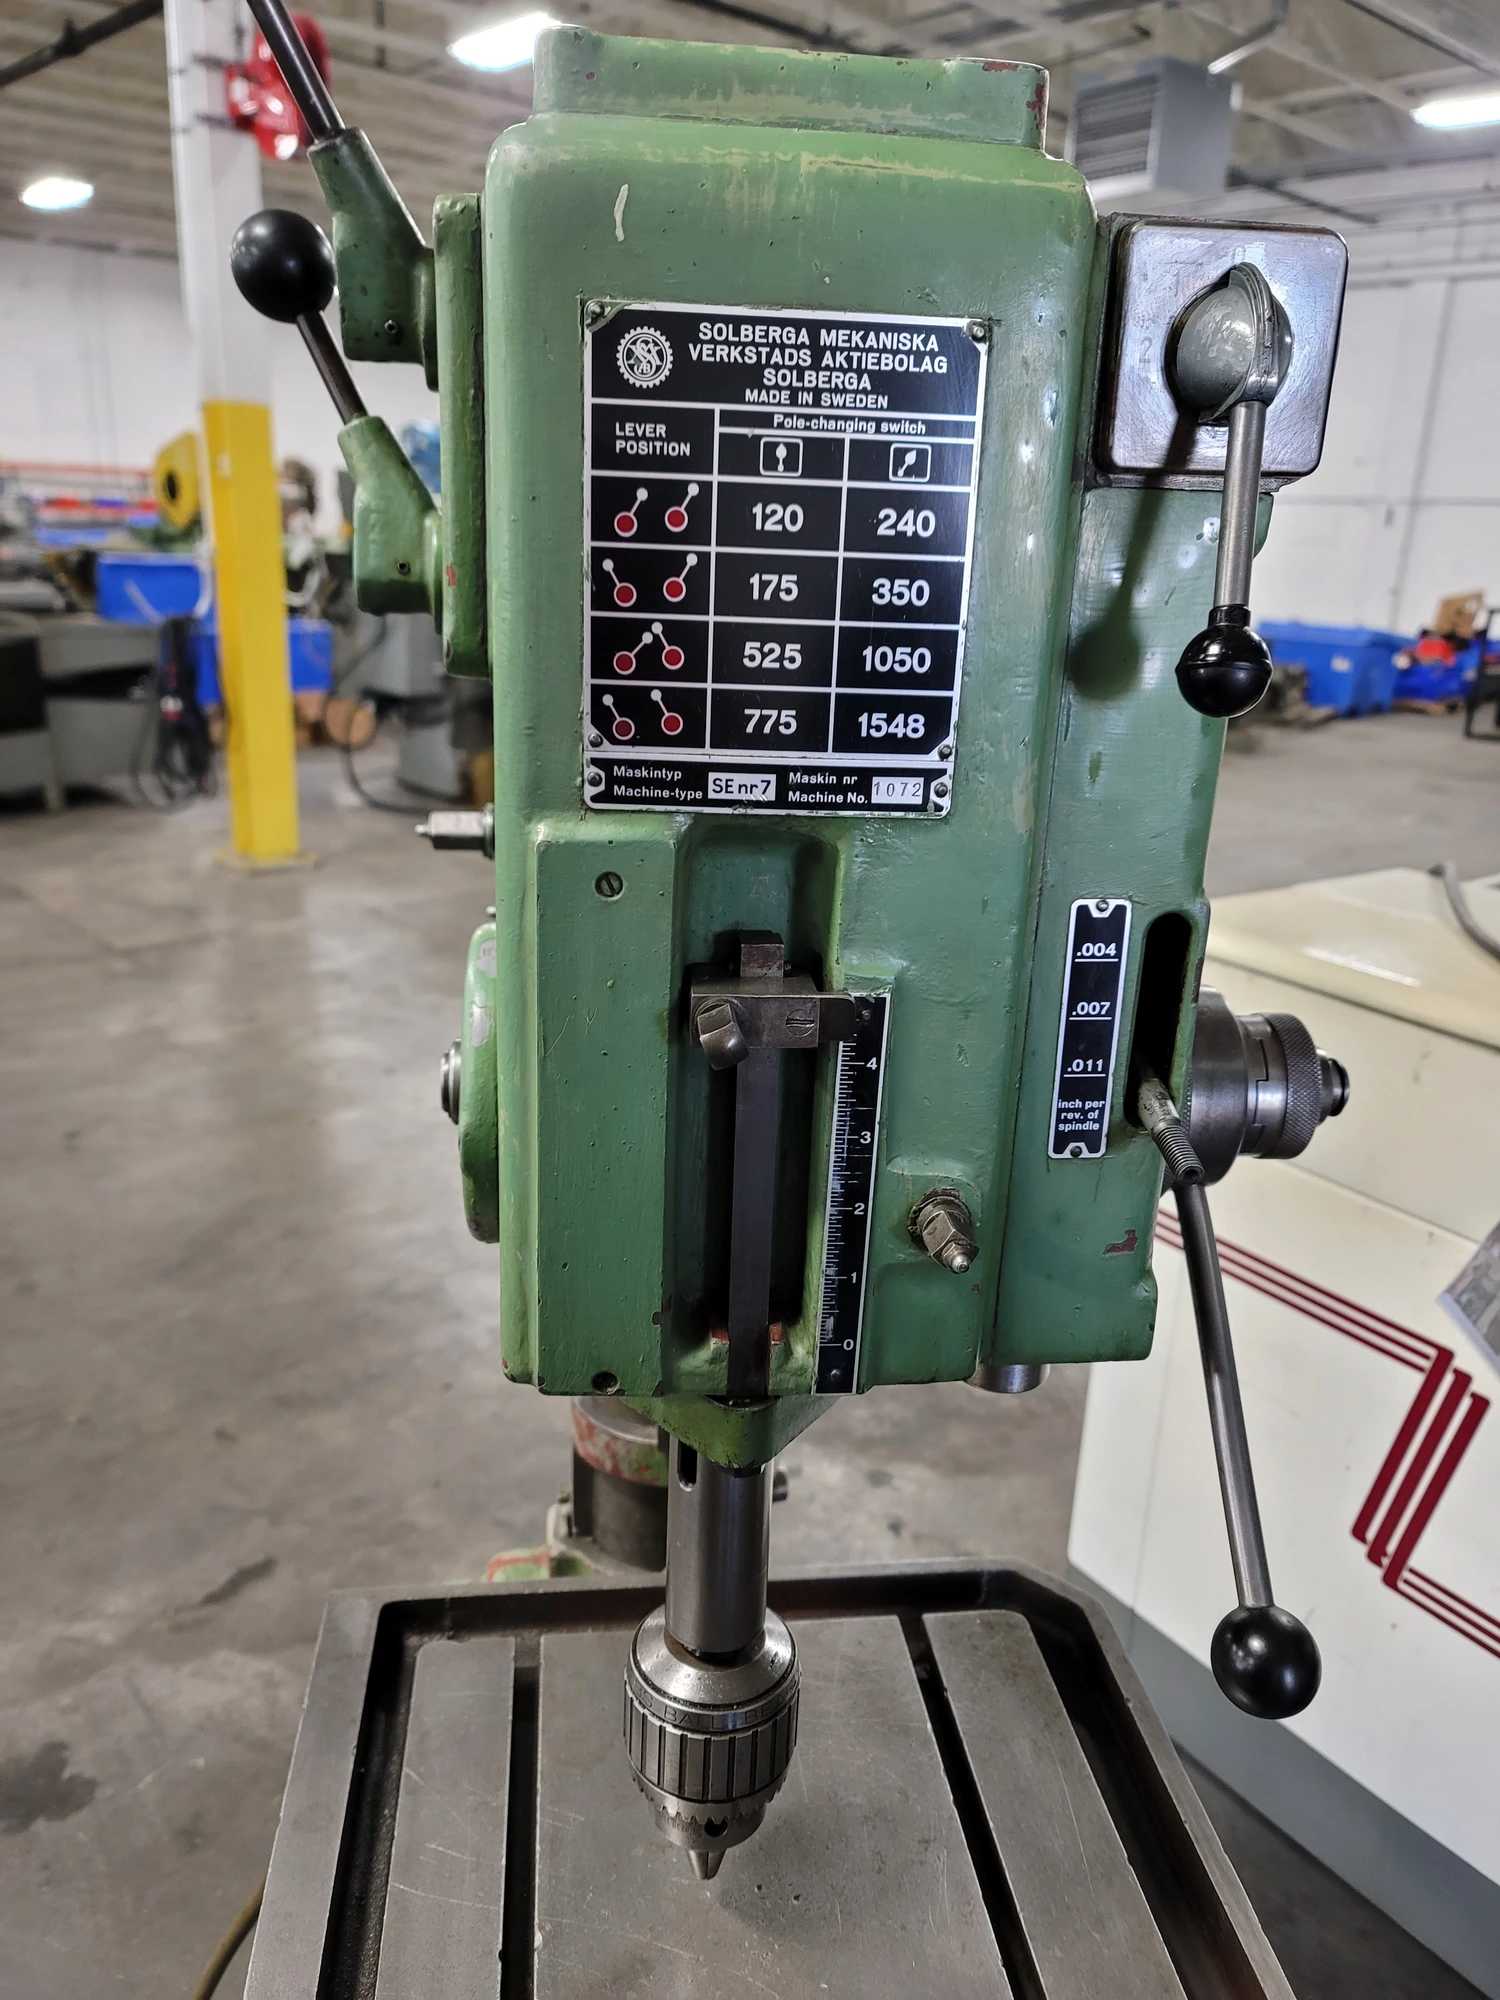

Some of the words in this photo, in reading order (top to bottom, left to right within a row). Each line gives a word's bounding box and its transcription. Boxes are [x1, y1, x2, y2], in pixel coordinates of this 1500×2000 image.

[698, 322, 810, 346] SOLBERGA
[819, 328, 939, 352] MEKANISKA
[689, 344, 813, 367] VERKSTADS
[821, 351, 948, 374] AKTIEBOLAG
[763, 368, 872, 391] SOLBERGA
[745, 388, 790, 405] MADE
[798, 391, 812, 406] IN
[821, 392, 888, 409] SWEDEN
[615, 422, 667, 438] LEVER
[774, 414, 876, 434] Pole-changing
[880, 420, 926, 435] switch
[615, 440, 690, 457] POSITION
[751, 503, 804, 533] 120
[877, 508, 936, 538] 240
[749, 573, 799, 602] 175
[871, 578, 930, 607] 350
[742, 641, 802, 670] 525
[862, 645, 932, 673] 1050
[744, 708, 797, 735] 775
[858, 712, 925, 739] 1548
[613, 766, 682, 781] Maskintyp
[788, 771, 838, 785] Maskin
[843, 774, 858, 785] nr
[613, 785, 703, 801] Machine-type
[788, 790, 842, 803] Machine
[847, 792, 868, 804] No.
[873, 782, 921, 797] 1072
[1077, 943, 1117, 957] .004
[1072, 1002, 1111, 1016] .007
[866, 1057, 877, 1070] 4
[1067, 1058, 1103, 1072] .011
[1058, 1099, 1083, 1109] inch
[1084, 1100, 1105, 1111] per
[1061, 1111, 1083, 1120] rev.
[1087, 1110, 1099, 1120] of
[1058, 1121, 1100, 1132] spindle
[860, 1131, 871, 1144] 3
[854, 1203, 865, 1215] 2
[850, 1272, 857, 1283] 1
[843, 1339, 854, 1351] 0
